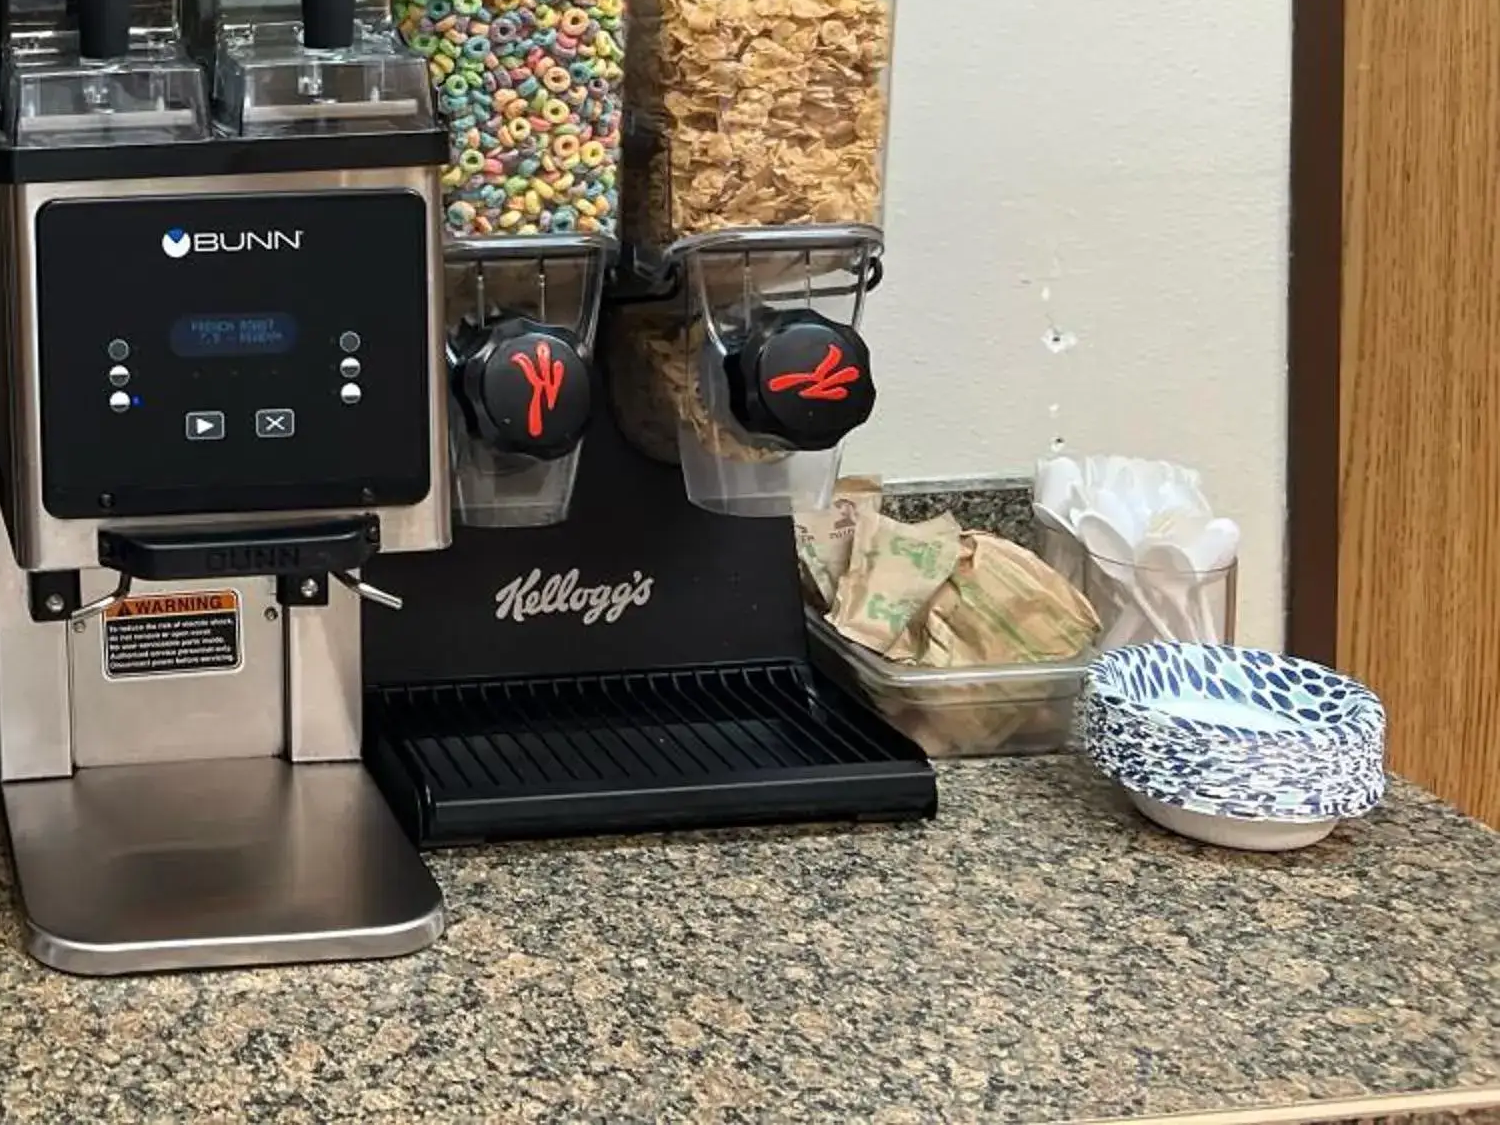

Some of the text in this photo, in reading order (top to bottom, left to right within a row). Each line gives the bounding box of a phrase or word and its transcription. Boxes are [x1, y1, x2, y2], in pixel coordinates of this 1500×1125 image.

[193, 231, 302, 252] BUNN
[136, 595, 222, 614] WARNING
[495, 568, 654, 625] Kellogg's
